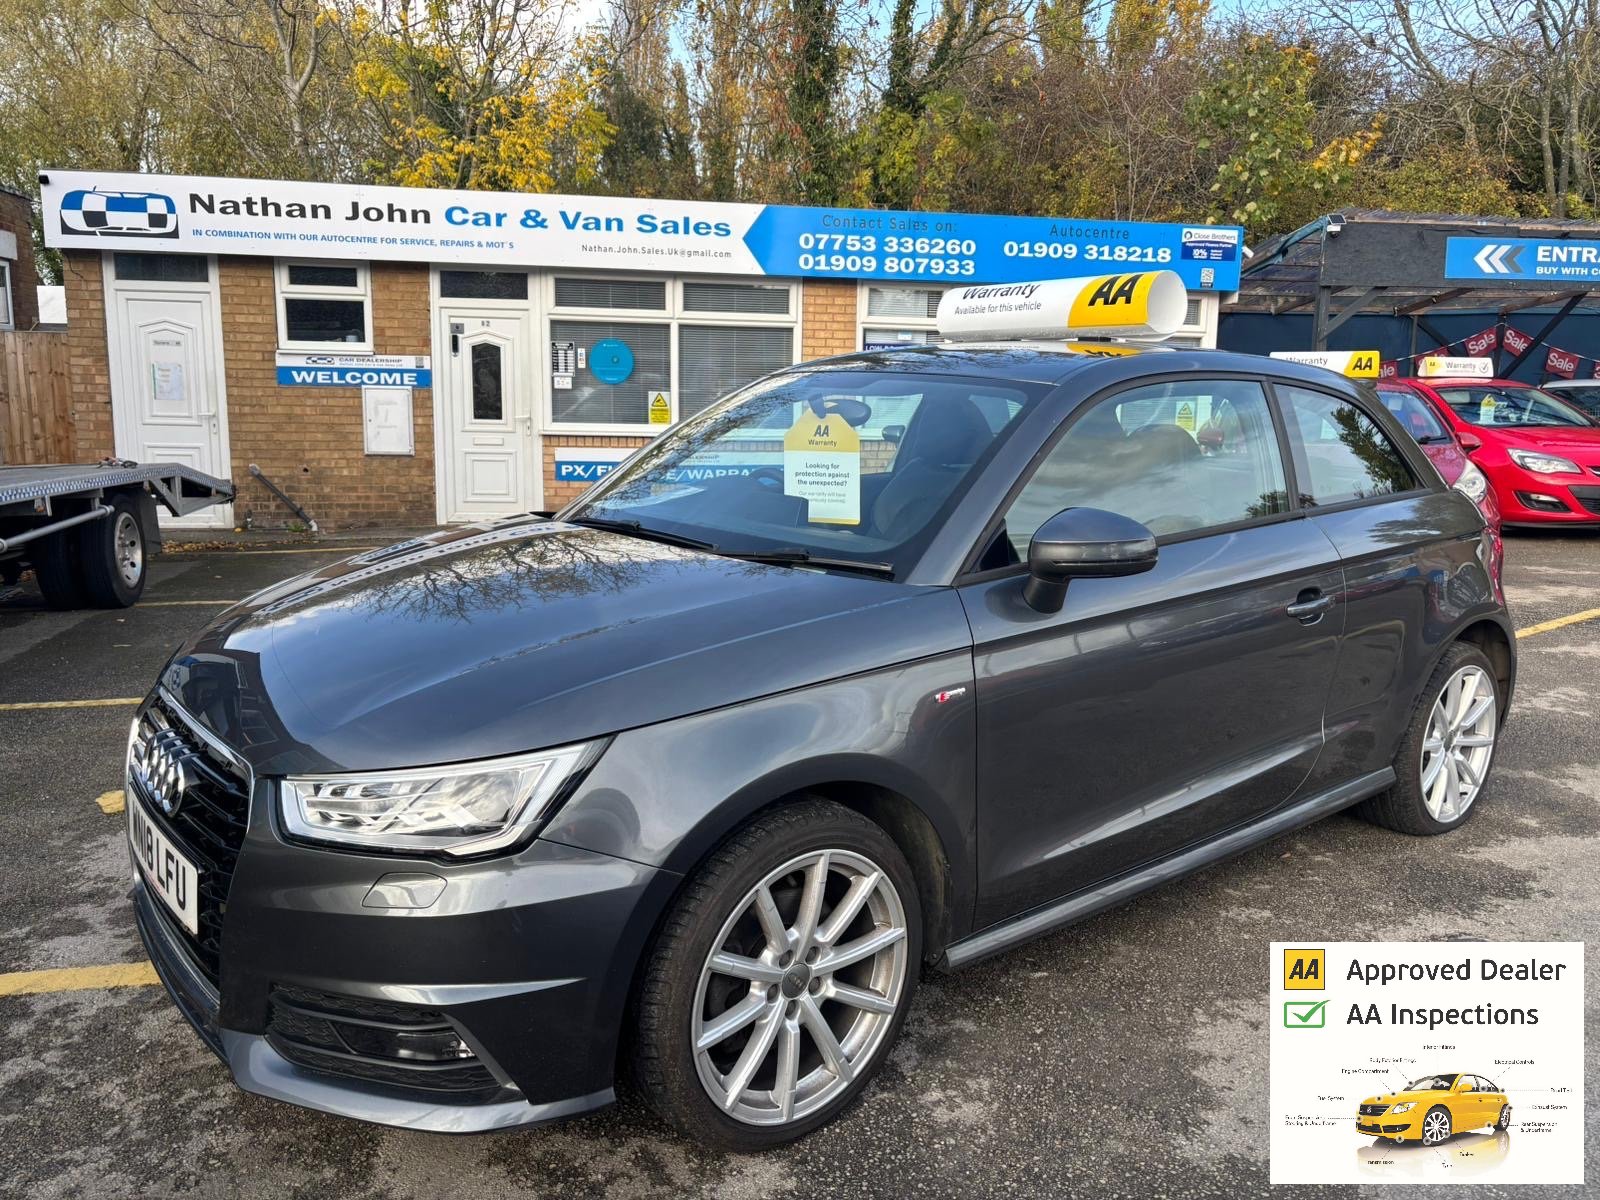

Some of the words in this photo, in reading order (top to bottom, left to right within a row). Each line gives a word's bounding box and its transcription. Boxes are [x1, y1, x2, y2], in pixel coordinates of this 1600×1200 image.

[189, 193, 331, 219] Nathan
[345, 202, 431, 224] John
[444, 206, 508, 227] Car
[520, 209, 548, 229] &
[560, 211, 624, 232] Van
[636, 214, 731, 237] Sales
[822, 214, 882, 230] Contact
[890, 217, 928, 232] Sales
[935, 222, 957, 233] on:
[205, 230, 271, 240] COMBINATION
[273, 232, 297, 240] WITH
[299, 233, 318, 241] OUR
[320, 235, 378, 244] AUTOCENTRE
[400, 237, 437, 247] SERVICE,
[440, 239, 475, 247] REPAIRS
[1049, 224, 1130, 239] Autocentre
[582, 244, 732, 259] Nathan.John.Sales.Uk@gmail.com
[799, 233, 876, 252] 07753
[884, 236, 976, 255] 336260
[1003, 241, 1078, 259] 01909
[1084, 244, 1172, 263] 318218
[1537, 245, 1600, 264] ENTR
[799, 254, 877, 272] 01909
[884, 257, 976, 276] 807933
[1536, 266, 1558, 275] BUY
[1561, 267, 1588, 275] WITH
[962, 284, 1041, 300] Warranty
[1087, 274, 1144, 307] AA
[954, 305, 985, 315] Available
[988, 304, 999, 313] for
[999, 303, 1013, 312] this
[1014, 301, 1042, 311] vehicle
[1468, 332, 1496, 354] Sale
[1504, 330, 1529, 352] Sale
[1286, 356, 1328, 366] Warranty
[1353, 357, 1373, 371] AA
[1445, 361, 1476, 369] Warranty
[1547, 353, 1574, 372] Sale
[291, 370, 418, 385] WELCOME
[813, 424, 829, 437] AA
[808, 439, 837, 447] Warranty
[805, 462, 829, 470] Looking
[794, 471, 827, 479] protection
[156, 837, 186, 911] LFU
